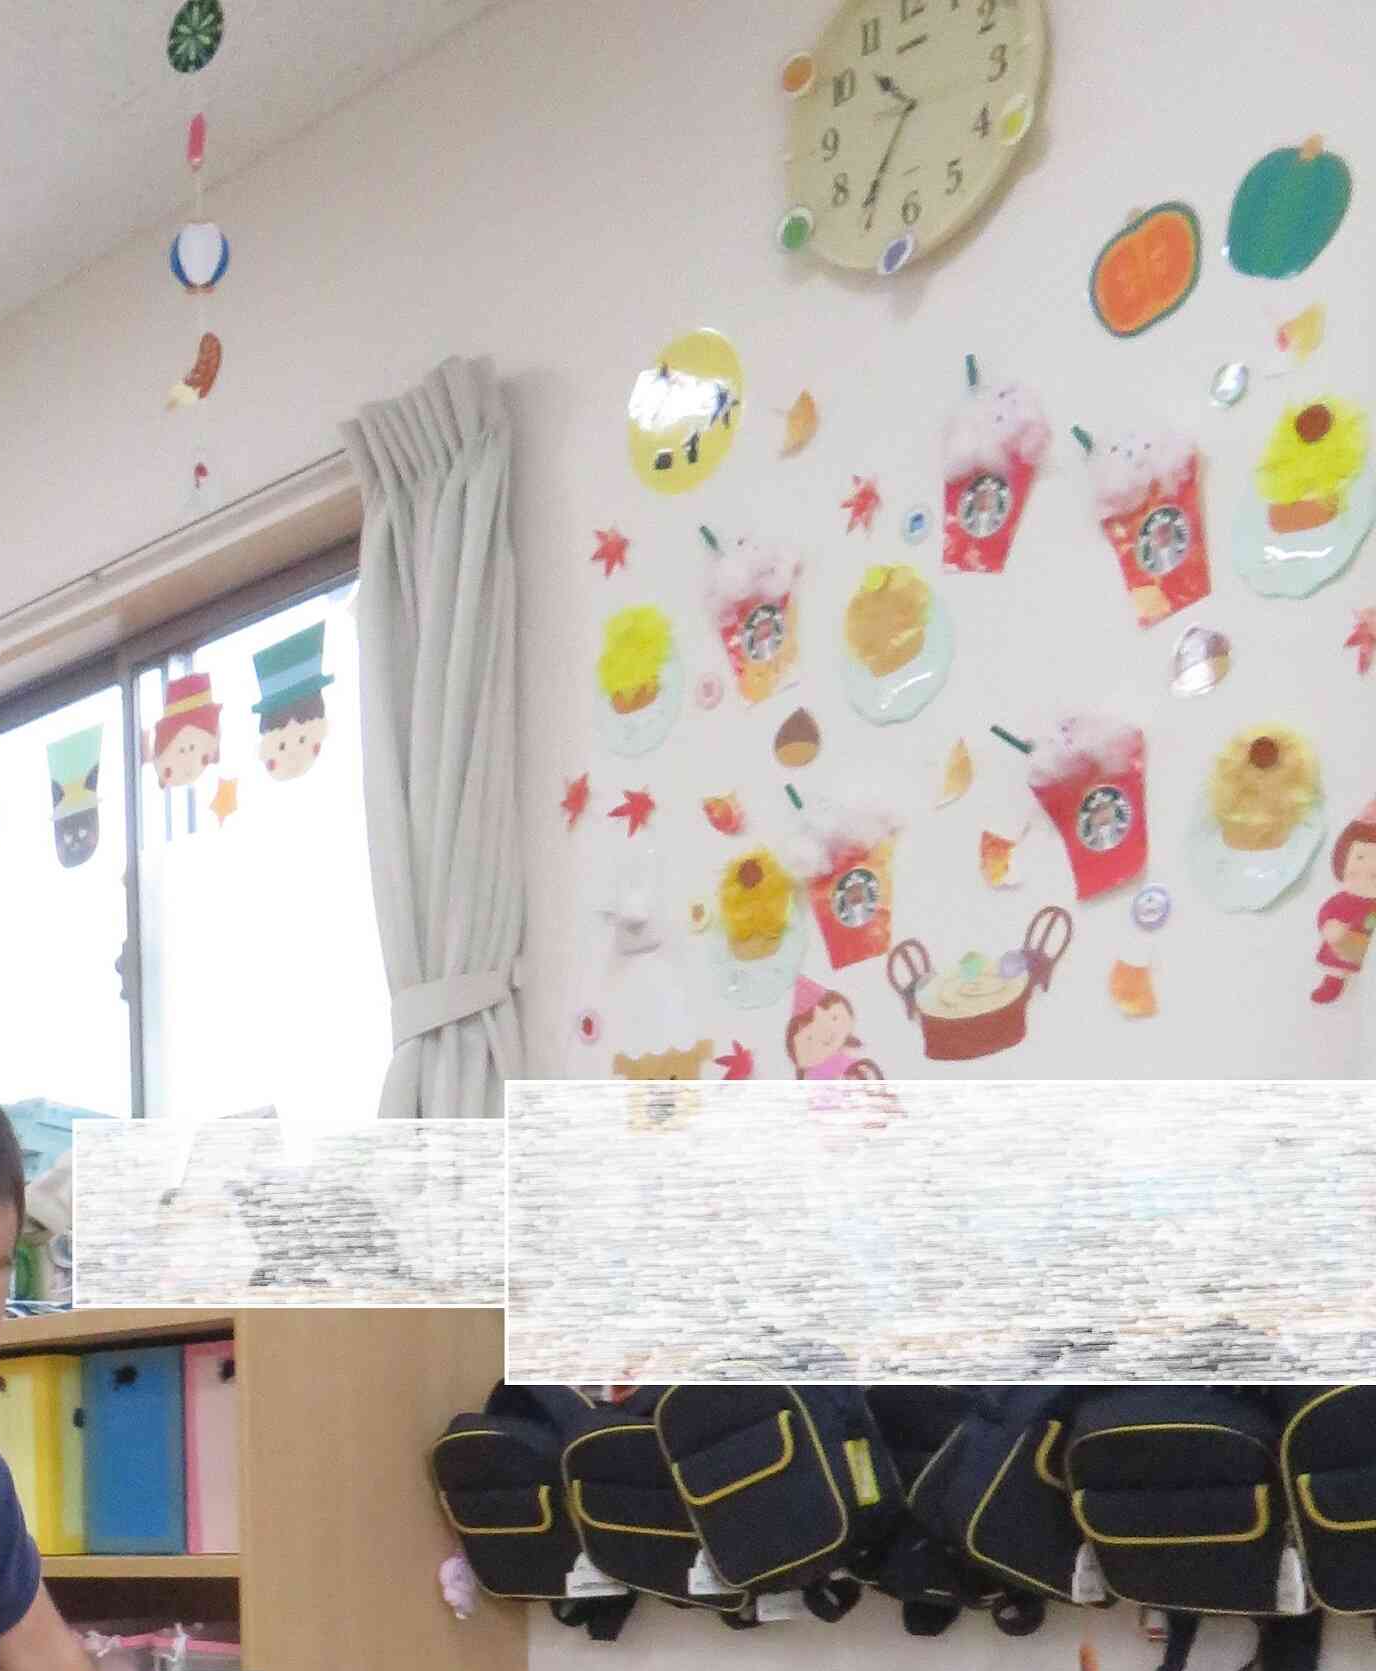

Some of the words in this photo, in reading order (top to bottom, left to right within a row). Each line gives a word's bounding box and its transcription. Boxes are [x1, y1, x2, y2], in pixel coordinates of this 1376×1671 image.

[860, 18, 879, 56] 11
[987, 44, 1008, 82] 3
[832, 67, 856, 107] 10
[972, 102, 991, 138] 4
[821, 127, 839, 162] 9
[831, 172, 849, 207] 8
[946, 157, 963, 195] 5
[901, 190, 922, 225] 6
